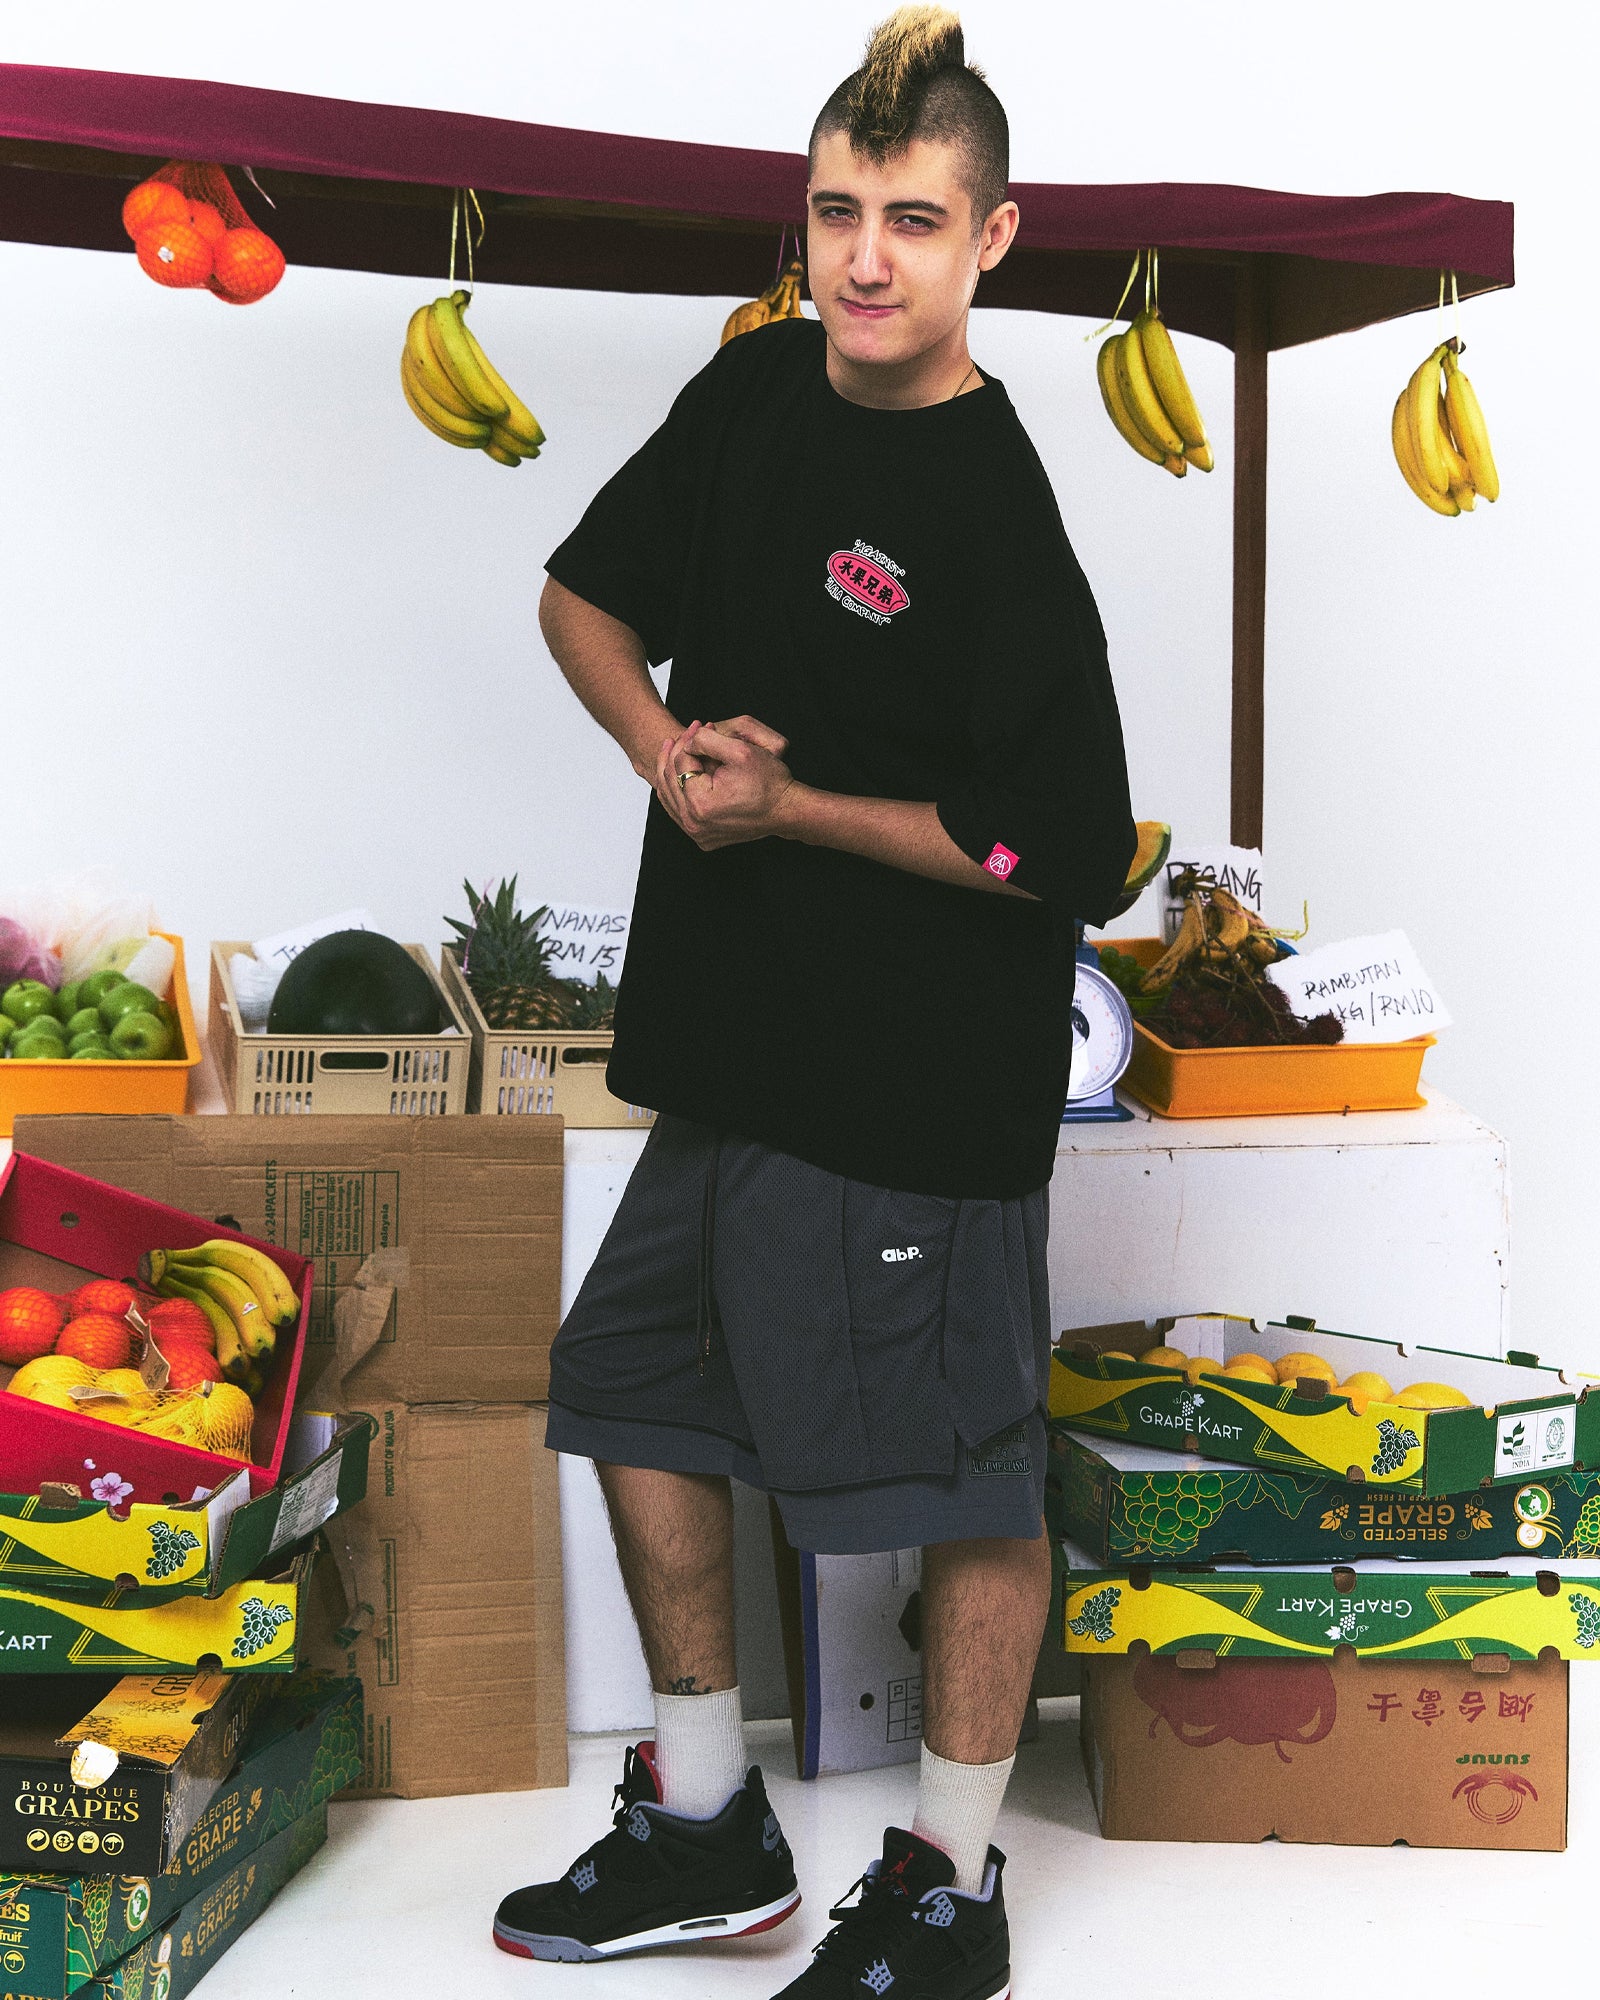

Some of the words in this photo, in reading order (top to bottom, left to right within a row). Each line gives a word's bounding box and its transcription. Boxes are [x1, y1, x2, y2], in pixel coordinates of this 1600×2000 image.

[838, 560, 894, 606] 水果兄弟
[541, 909, 627, 934] NANAS
[546, 939, 585, 962] RM
[589, 944, 622, 968] 15
[1301, 959, 1401, 1000] RAMBUTAN
[264, 1159, 277, 1227] 24PACKETS
[302, 1190, 312, 1239] Malaysia
[315, 1210, 325, 1254] Premium
[384, 1409, 395, 1448] MALAYSIA
[384, 1449, 395, 1460] OF
[1512, 1459, 1530, 1469] INDIA
[384, 1460, 395, 1498] PRODUCT
[1367, 1493, 1394, 1502] FRESH
[1358, 1504, 1455, 1525] GRAPE
[1363, 1528, 1448, 1541] SELECTED
[1367, 1687, 1537, 1728] 烟台富士
[14, 1793, 140, 1823] GRAPES
[21, 1780, 138, 1799] BOUTIQUE
[191, 1791, 239, 1837] SELECTED
[186, 1806, 242, 1866] GRAPE
[202, 1870, 239, 1917] SELECTED
[196, 1885, 241, 1946] GRAPE
